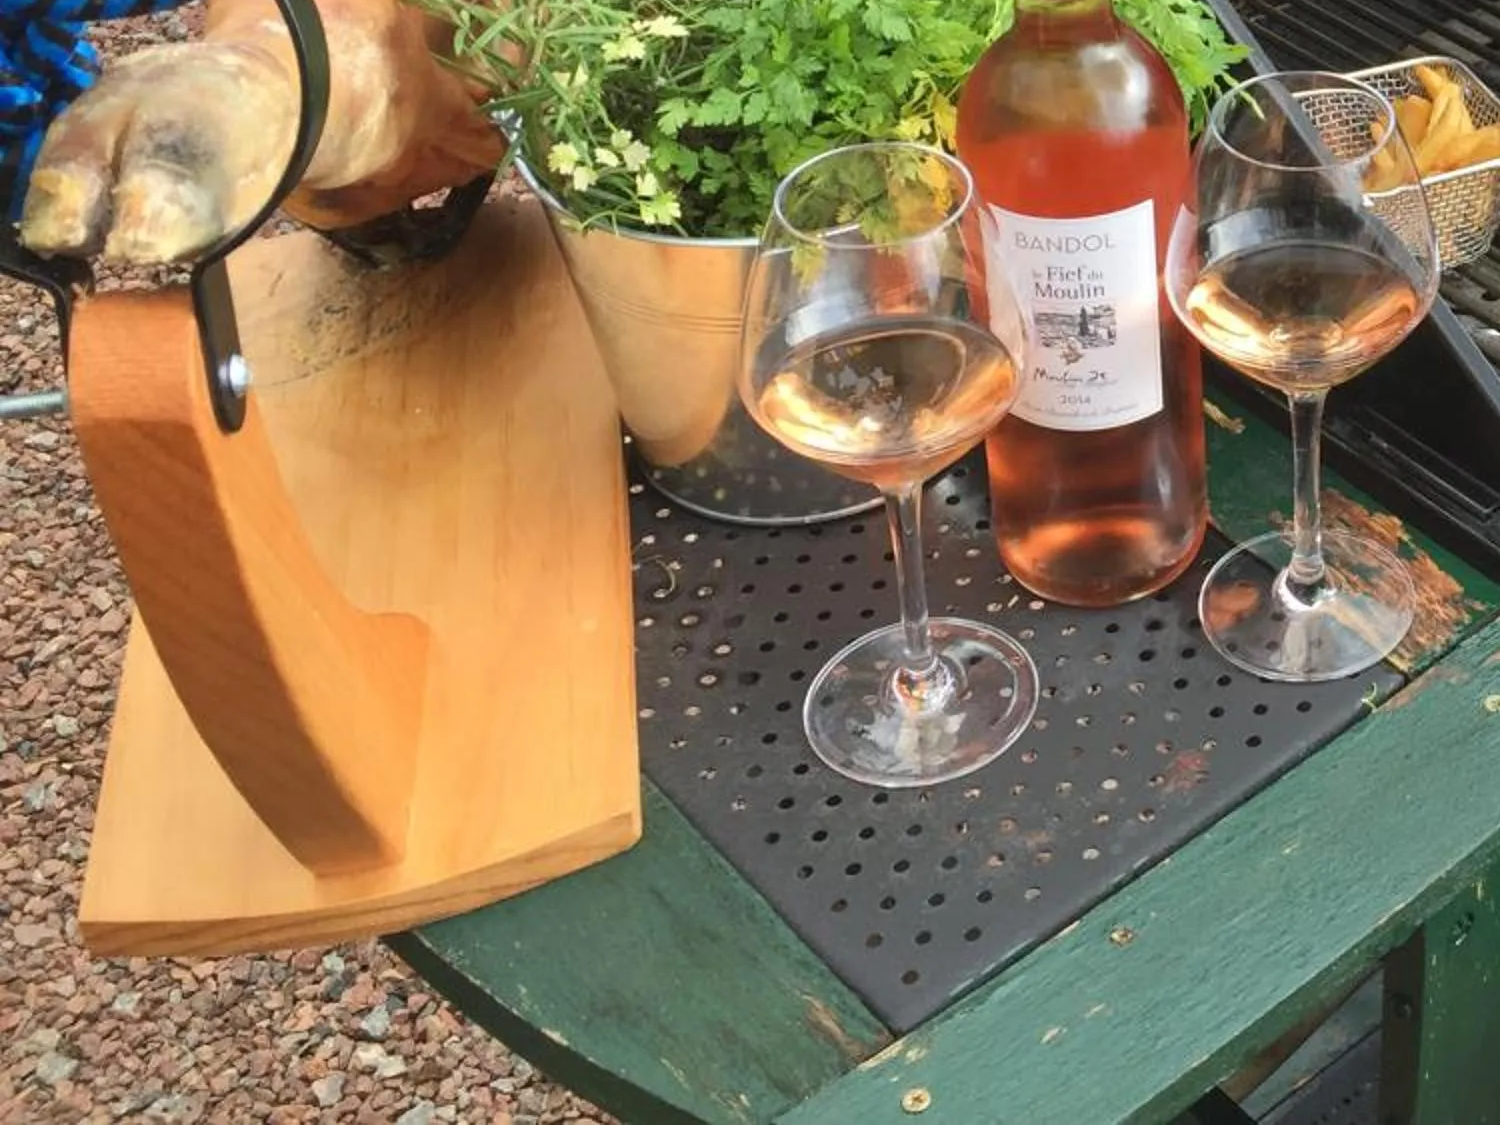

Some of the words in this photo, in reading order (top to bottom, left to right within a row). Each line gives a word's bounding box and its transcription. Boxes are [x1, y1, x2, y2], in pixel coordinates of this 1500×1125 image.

[1015, 231, 1118, 254] BANDOL
[1046, 264, 1087, 282] Fief
[1034, 283, 1106, 300] Moulin
